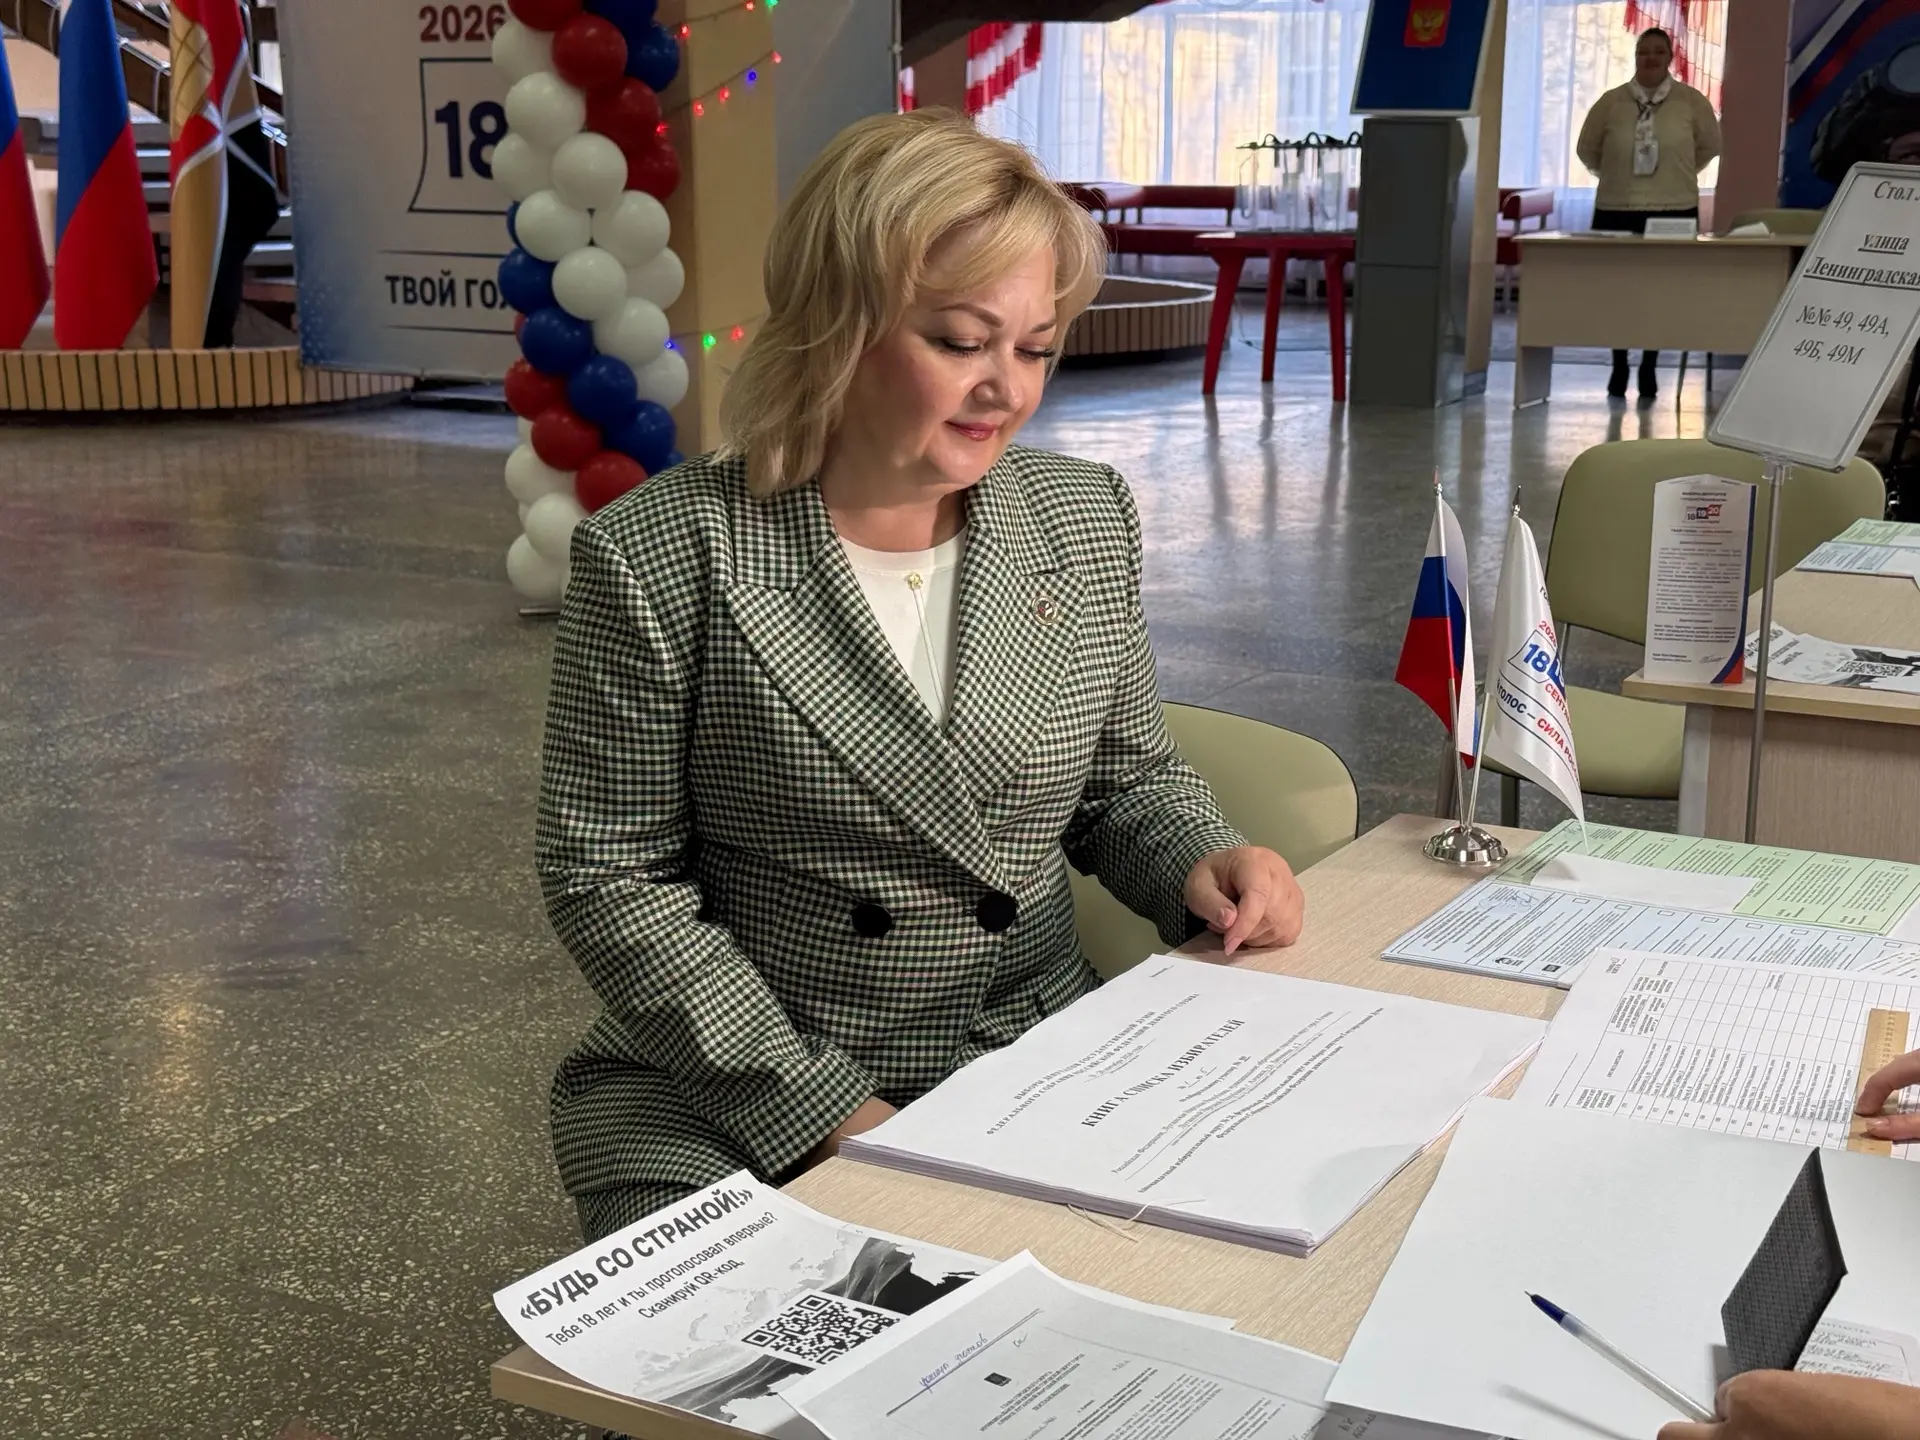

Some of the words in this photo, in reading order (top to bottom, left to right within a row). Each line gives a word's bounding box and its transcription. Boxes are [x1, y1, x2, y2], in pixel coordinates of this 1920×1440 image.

[419, 5, 505, 42] 2026
[435, 100, 508, 180] 18
[1874, 181, 1915, 201] Стол
[1863, 234, 1910, 251] улица
[385, 269, 457, 309] ТВОЙ
[1833, 311, 1854, 333] 49,
[1858, 313, 1889, 339] 49А,
[1793, 339, 1824, 364] 49Б,
[1827, 344, 1865, 365] 49М
[1523, 643, 1550, 672] 18
[1537, 718, 1563, 749] СИЛА
[1081, 1097, 1128, 1127] КНИГА
[1123, 1073, 1175, 1095] СПИСКА
[1167, 1020, 1245, 1071] ИЗБИРАТЕЛЕЙ
[520, 1270, 599, 1320] «БУДЬ
[595, 1247, 634, 1277] СО
[631, 1188, 753, 1257] СТРАНОЙ!»
[545, 1325, 583, 1346] Тебе
[577, 1313, 598, 1328] 18
[595, 1302, 620, 1320] лет
[617, 1297, 632, 1307] и
[627, 1287, 648, 1301] ты
[645, 1242, 728, 1291] проголосовал
[723, 1211, 778, 1247] впервые?
[638, 1282, 701, 1319] Сканируй
